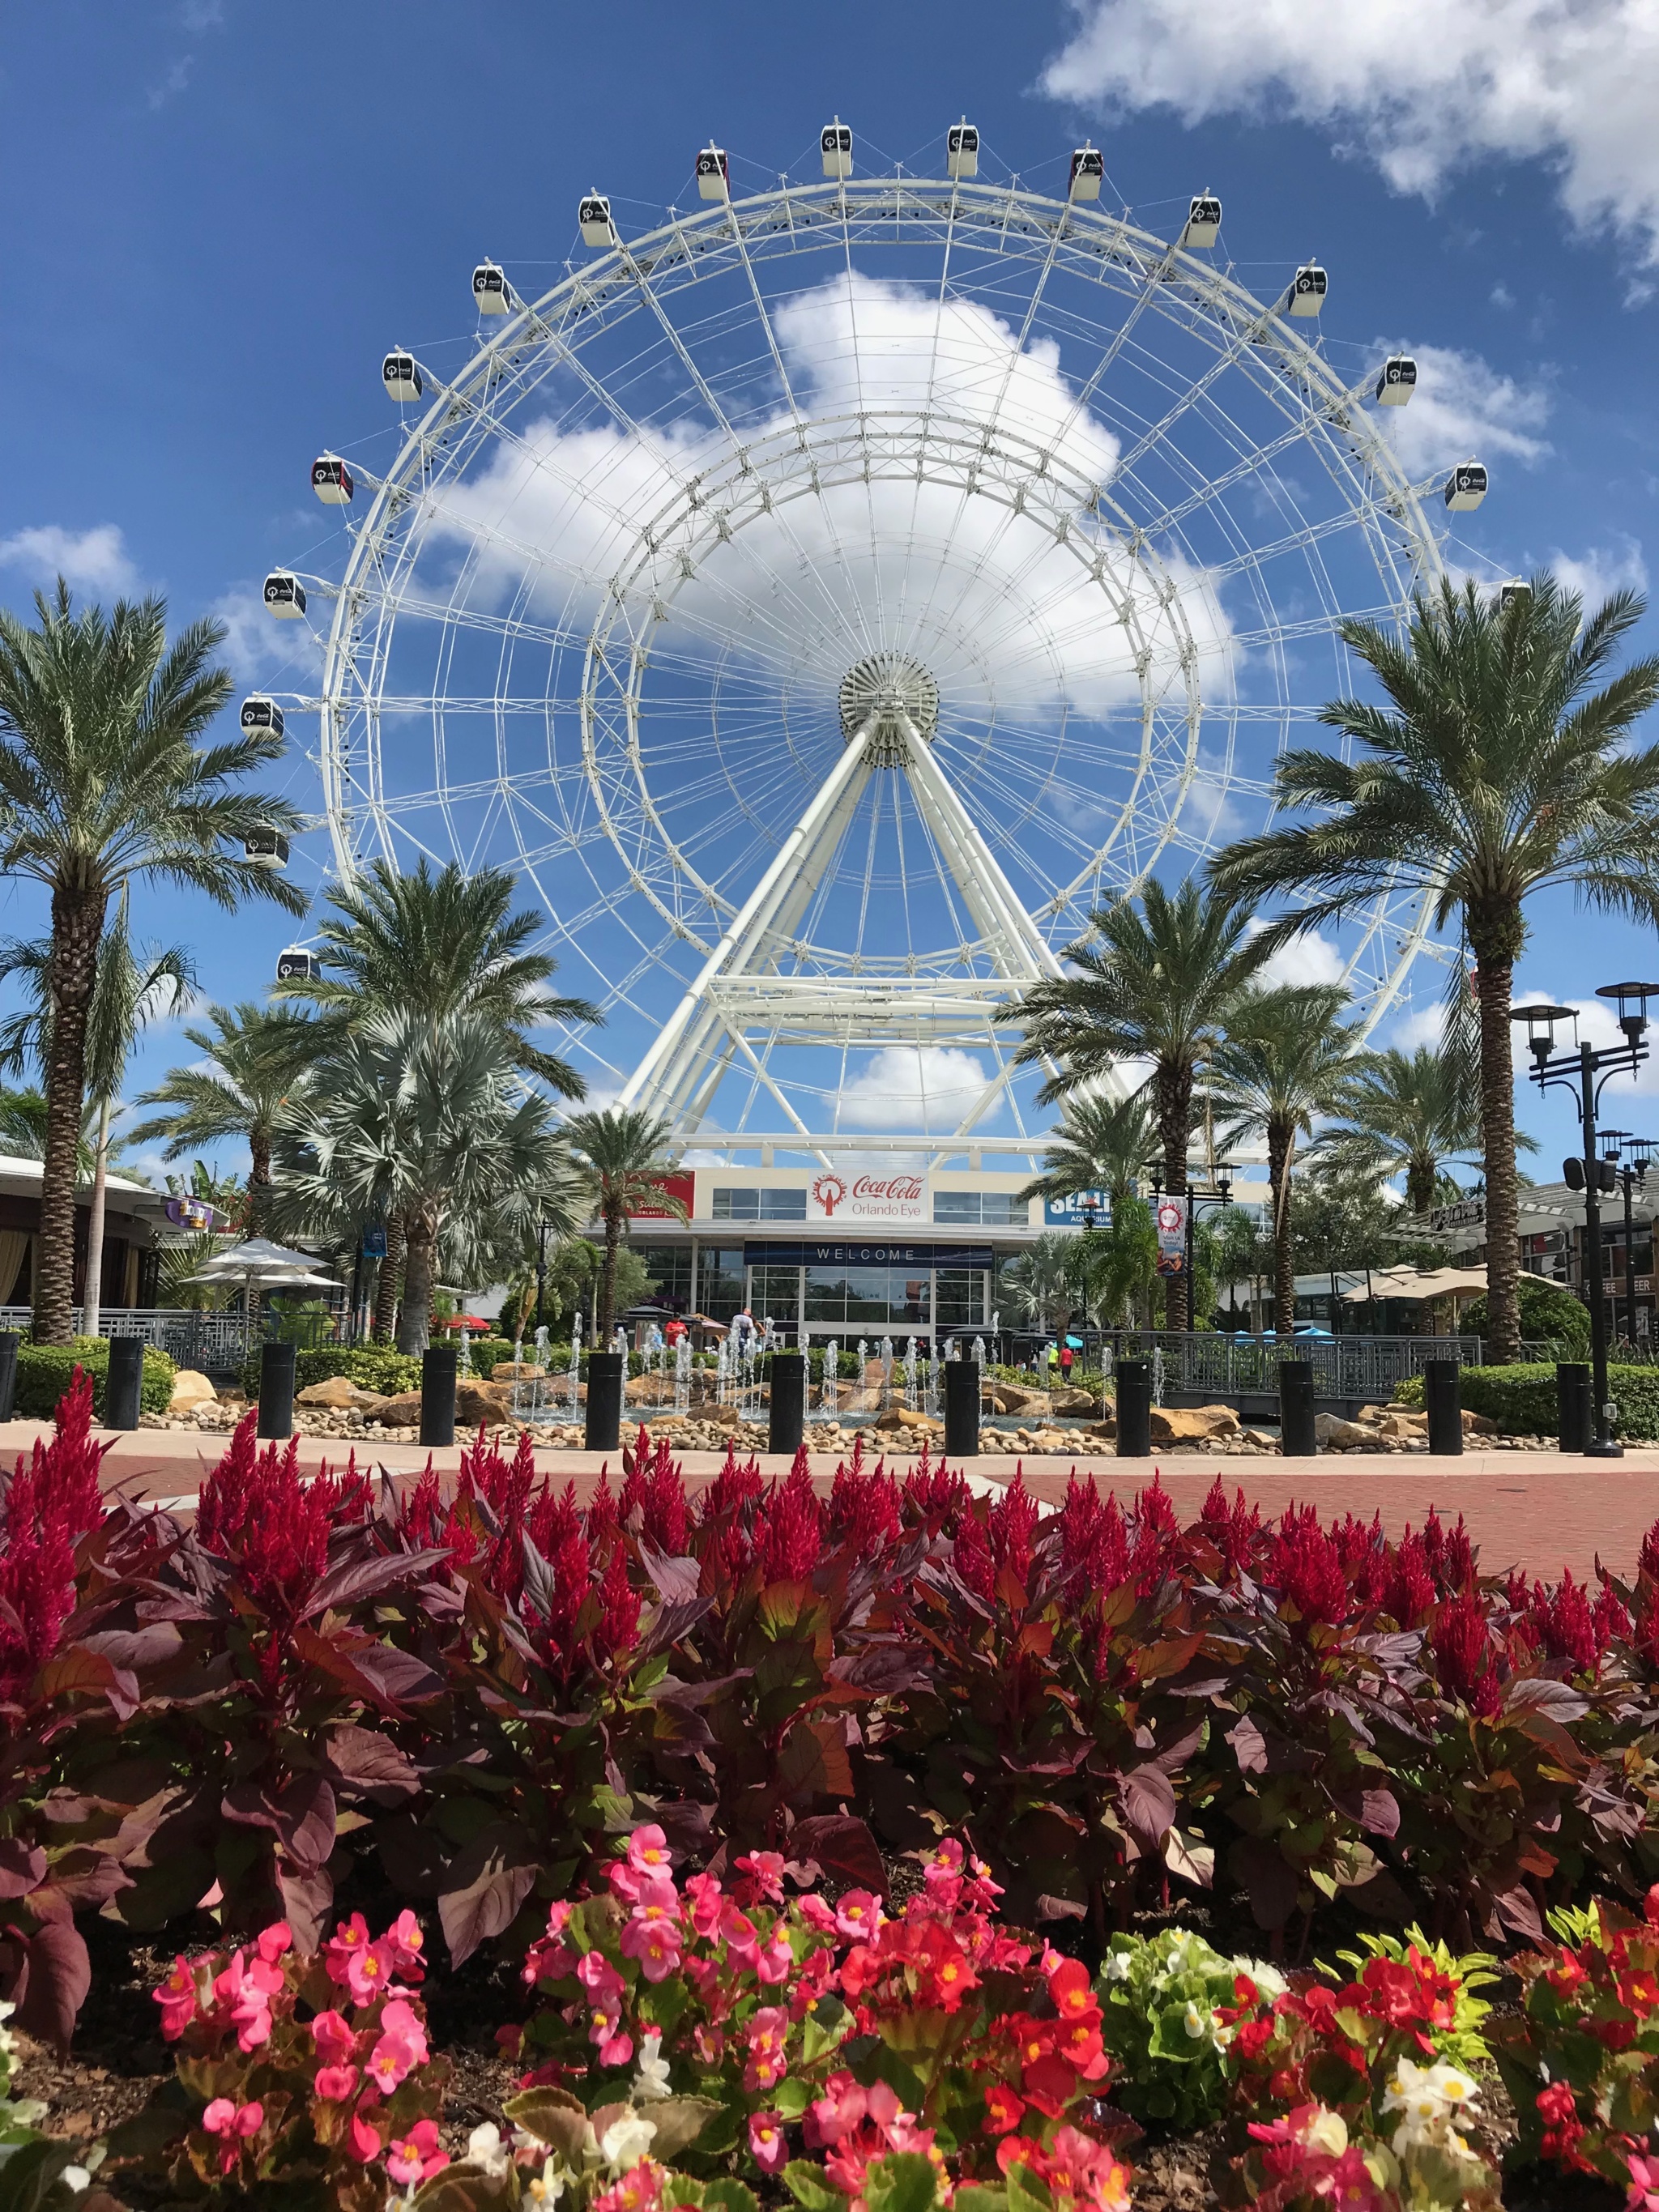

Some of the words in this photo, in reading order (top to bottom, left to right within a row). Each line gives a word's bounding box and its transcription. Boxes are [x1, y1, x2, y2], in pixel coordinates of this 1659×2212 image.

[852, 1175, 925, 1200] Coca-Cola
[1050, 1191, 1090, 1214] SEA
[852, 1204, 898, 1215] Orlando
[901, 1204, 921, 1218] Eye
[1071, 1215, 1111, 1223] AQURIUM
[817, 1248, 914, 1260] WELCOME
[1634, 1280, 1650, 1292] EER
